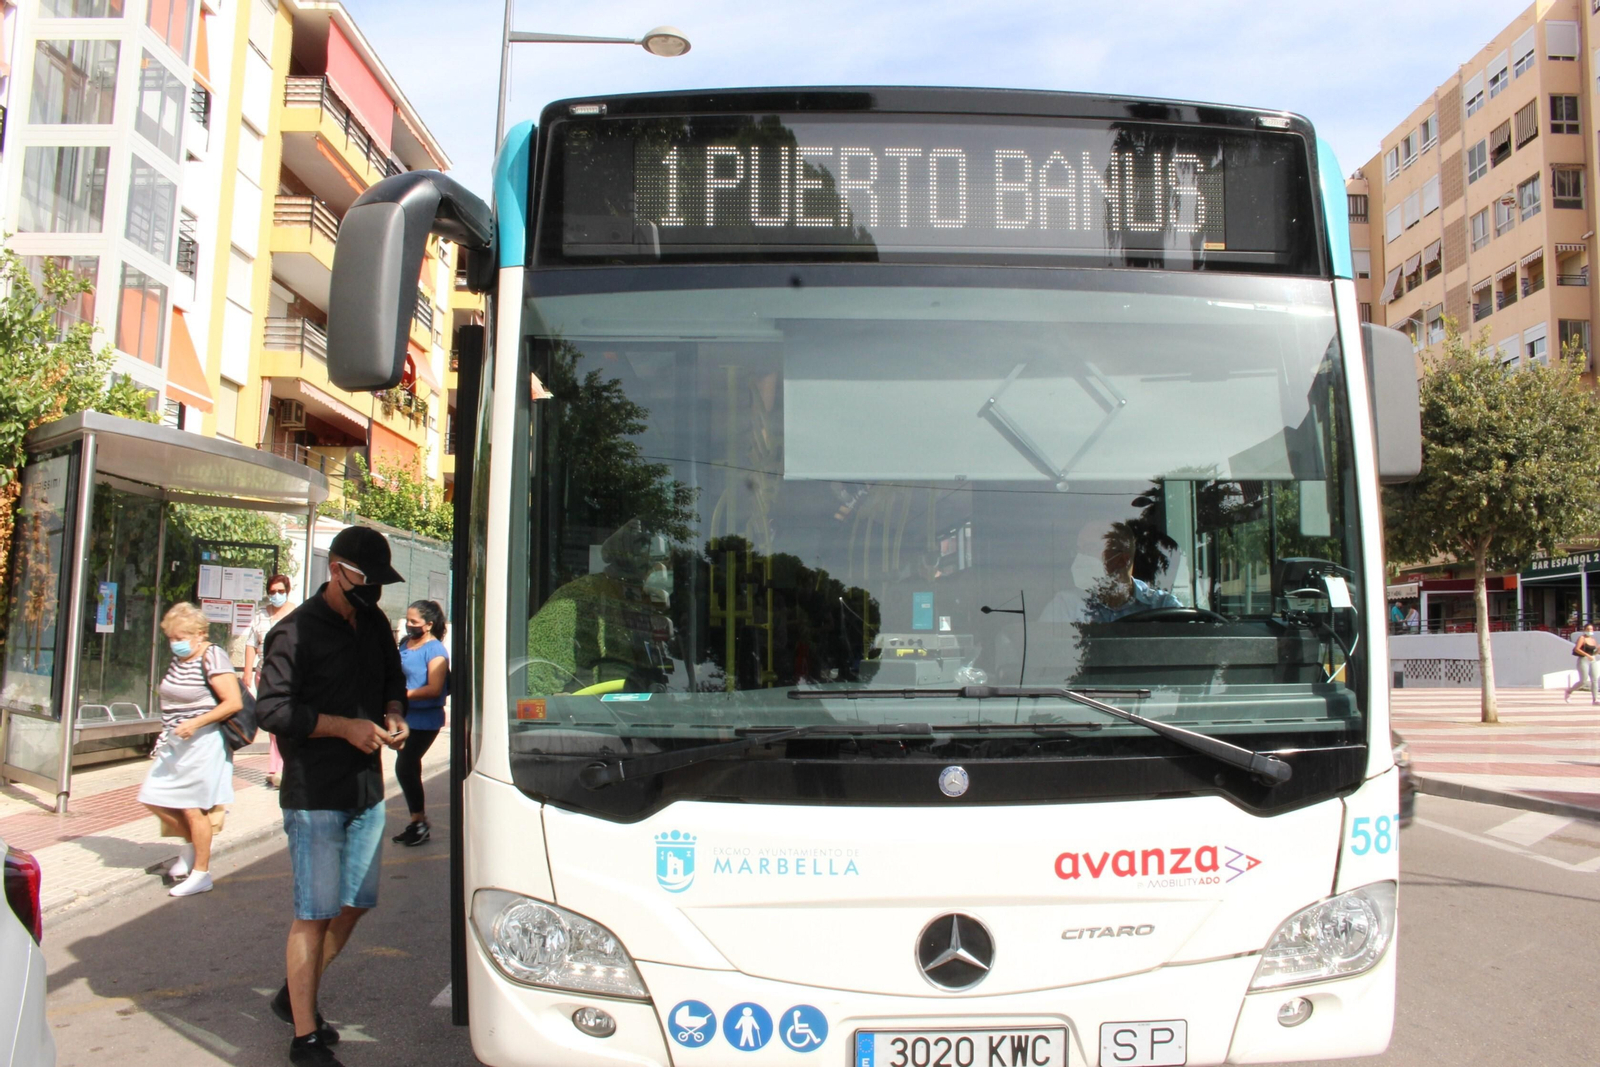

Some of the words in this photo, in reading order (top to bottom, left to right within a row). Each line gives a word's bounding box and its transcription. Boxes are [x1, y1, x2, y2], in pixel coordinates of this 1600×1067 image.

[660, 145, 684, 226] 1
[706, 145, 967, 228] PUERTO
[995, 149, 1206, 233] BANUS
[1532, 560, 1549, 570] BAR
[758, 848, 843, 857] AYUNTAMIENTO
[846, 848, 860, 857] DE
[713, 857, 860, 876] MARBELLA
[1054, 845, 1220, 880] avanza
[1061, 924, 1155, 940] CITARO
[890, 1036, 974, 1067] 3020
[988, 1034, 1051, 1067] KWC
[861, 1057, 871, 1067] E
